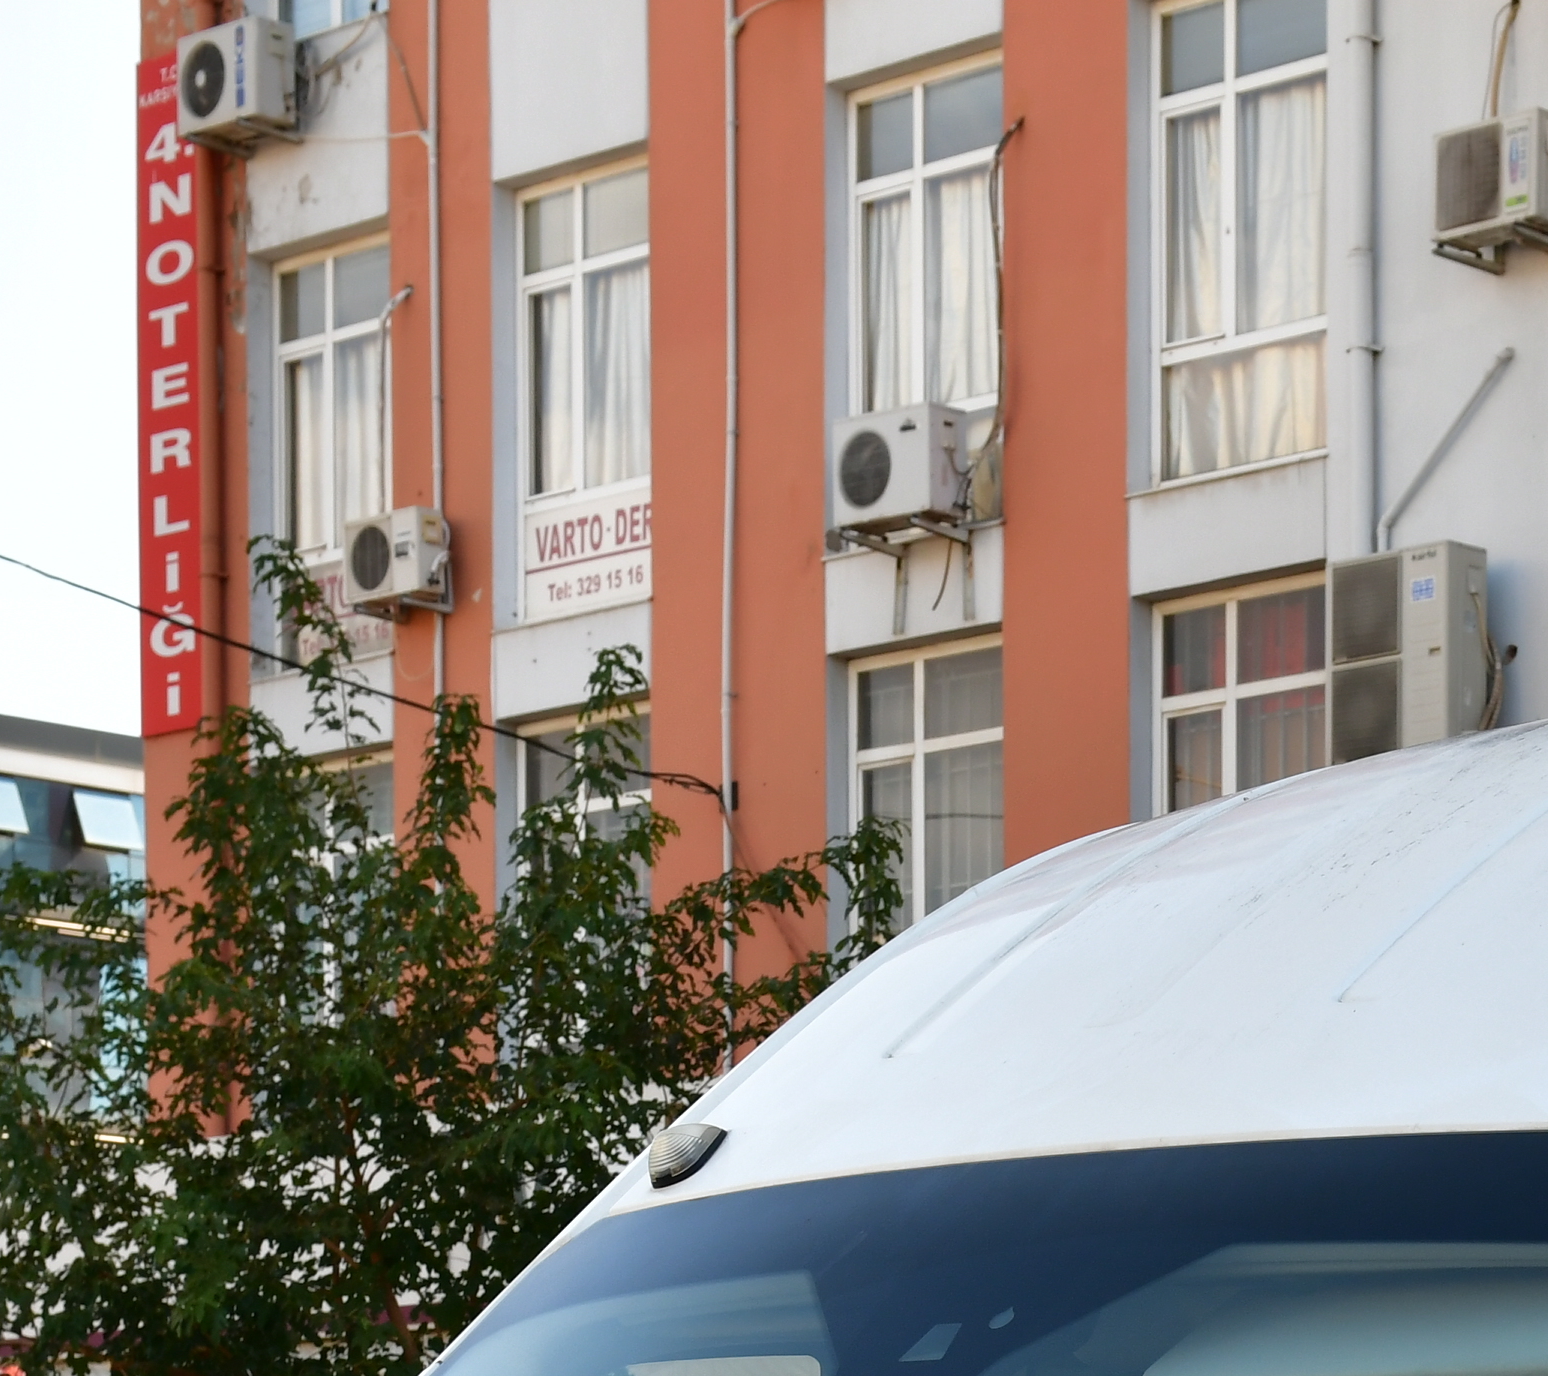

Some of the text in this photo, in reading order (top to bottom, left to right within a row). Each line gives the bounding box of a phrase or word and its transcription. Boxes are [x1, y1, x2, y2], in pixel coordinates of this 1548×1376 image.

[548, 564, 644, 602] Tel: 329 15 16
